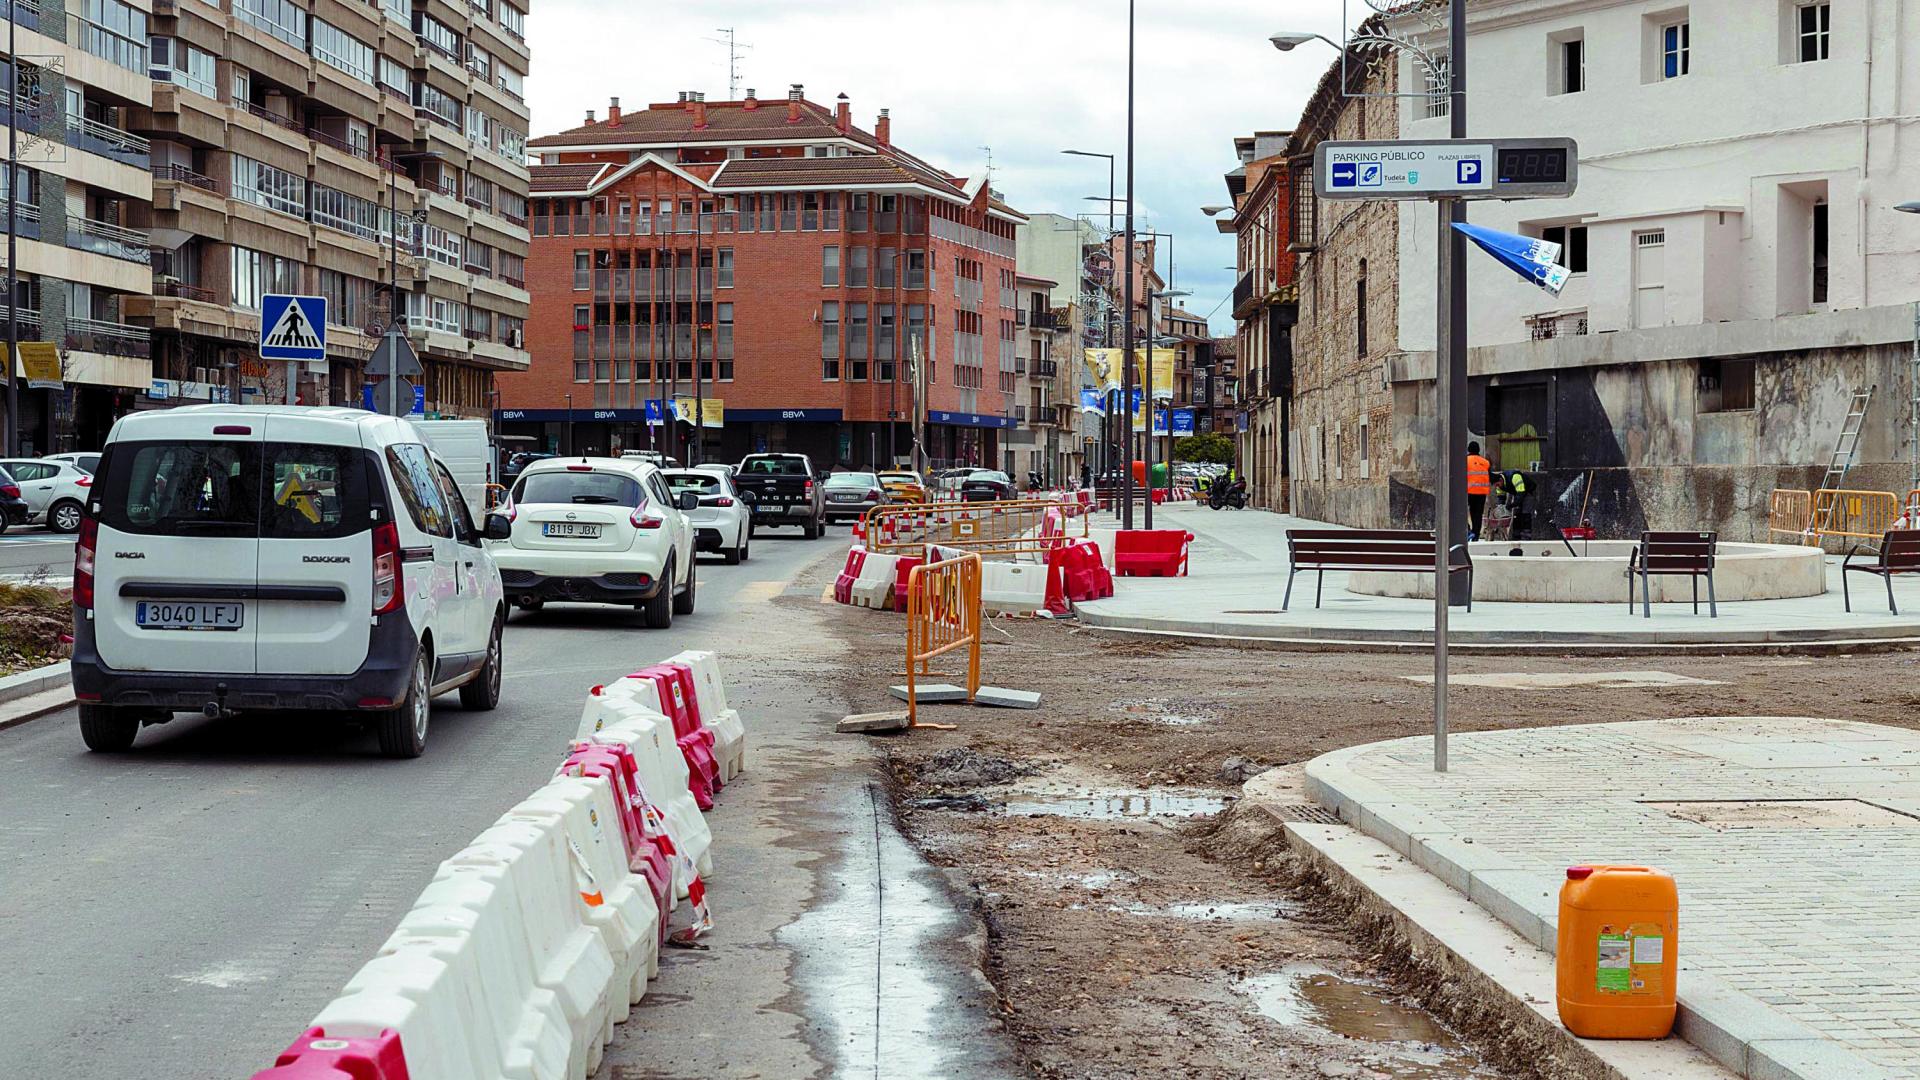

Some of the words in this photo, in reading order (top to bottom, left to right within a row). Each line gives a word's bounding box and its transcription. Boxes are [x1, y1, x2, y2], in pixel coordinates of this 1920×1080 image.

[1333, 153, 1378, 162] PARKING
[1380, 150, 1425, 161] PÚBLICO
[1460, 163, 1477, 181] P
[503, 411, 525, 419] BBVA
[594, 411, 616, 419] BBVA
[782, 411, 804, 419] BBVA
[549, 524, 574, 534] 8119
[579, 525, 597, 536] JBX
[115, 551, 146, 560] DACIA
[302, 555, 351, 564] DOKKER
[150, 605, 196, 623] 3040
[202, 606, 238, 624] LFJ
